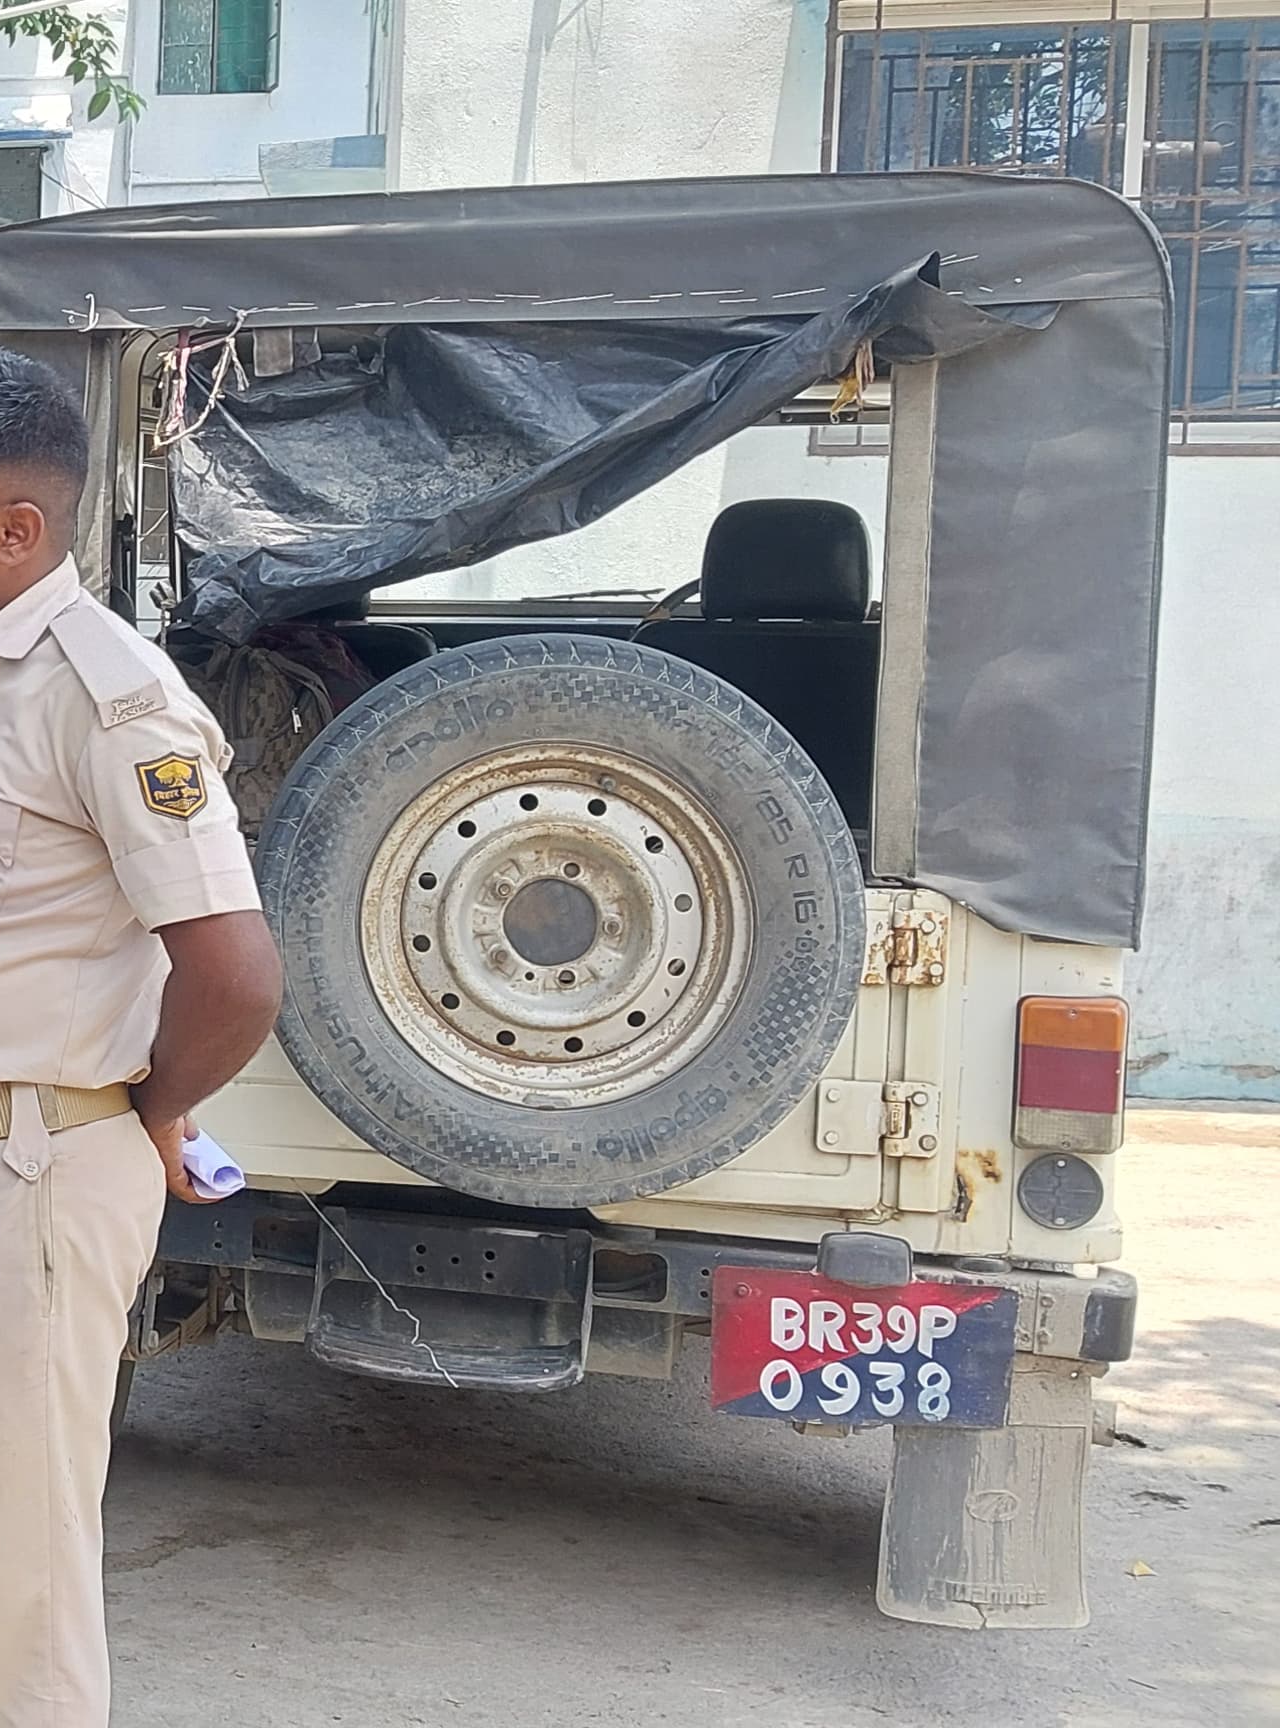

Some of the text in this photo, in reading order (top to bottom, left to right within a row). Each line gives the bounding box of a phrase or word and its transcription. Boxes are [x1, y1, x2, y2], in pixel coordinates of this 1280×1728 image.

[384, 693, 515, 774] apollo
[771, 1297, 957, 1358] BR39P
[759, 1359, 952, 1421] 0938
